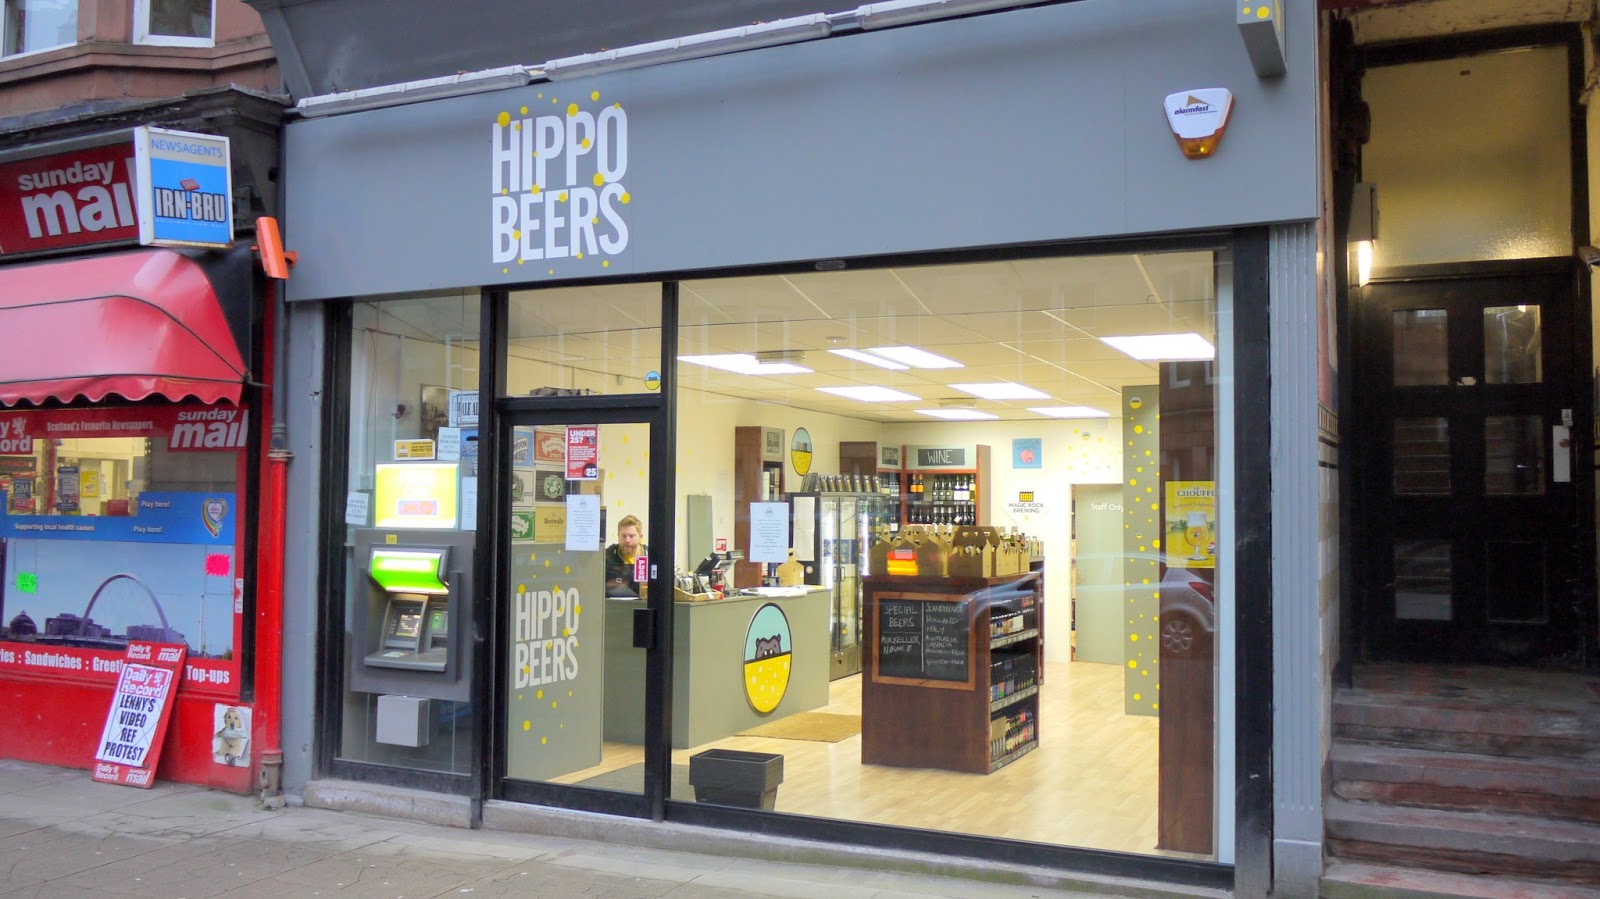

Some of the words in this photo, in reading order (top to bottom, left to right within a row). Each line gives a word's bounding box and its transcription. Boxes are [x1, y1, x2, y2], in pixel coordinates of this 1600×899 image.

[1174, 105, 1209, 115] alarmfast
[151, 138, 223, 158] NEWSAGENTS
[492, 105, 628, 194] HIPPO
[17, 160, 115, 192] sunday
[154, 187, 226, 223] IRN-BRU
[492, 182, 629, 263] BEERS
[178, 408, 238, 422] sunday
[47, 422, 79, 431] Scotland's
[81, 421, 111, 430] Favourite
[112, 421, 153, 430] Newspapers
[170, 409, 249, 448] mail
[0, 435, 31, 452] ord
[927, 449, 953, 464] WINE
[141, 500, 154, 509] Play
[155, 500, 171, 508] here!
[1090, 502, 1108, 511] Staff
[1108, 503, 1124, 513] Only
[15, 523, 43, 532] Supporting
[44, 523, 57, 531] local
[58, 523, 75, 531] health
[133, 525, 146, 534] Play
[515, 587, 579, 642] HIPPO
[884, 604, 918, 615] SPECIAL
[889, 617, 915, 627] BEERS
[926, 615, 959, 624] HOLLAND
[127, 651, 151, 659] Record
[129, 644, 145, 653] Daily
[158, 648, 183, 662] mail
[25, 651, 82, 670] Sandwiches
[93, 656, 123, 673] Greeti
[186, 665, 230, 684] Top-ups
[515, 635, 579, 689] BEERS
[125, 667, 154, 686] Daily
[121, 681, 164, 697] Record
[119, 694, 156, 713] LENNY'S
[119, 710, 147, 728] VIDEO
[120, 727, 137, 743] REF
[103, 741, 144, 761] PROTEST
[95, 770, 119, 781] Record
[126, 770, 151, 785] mail
